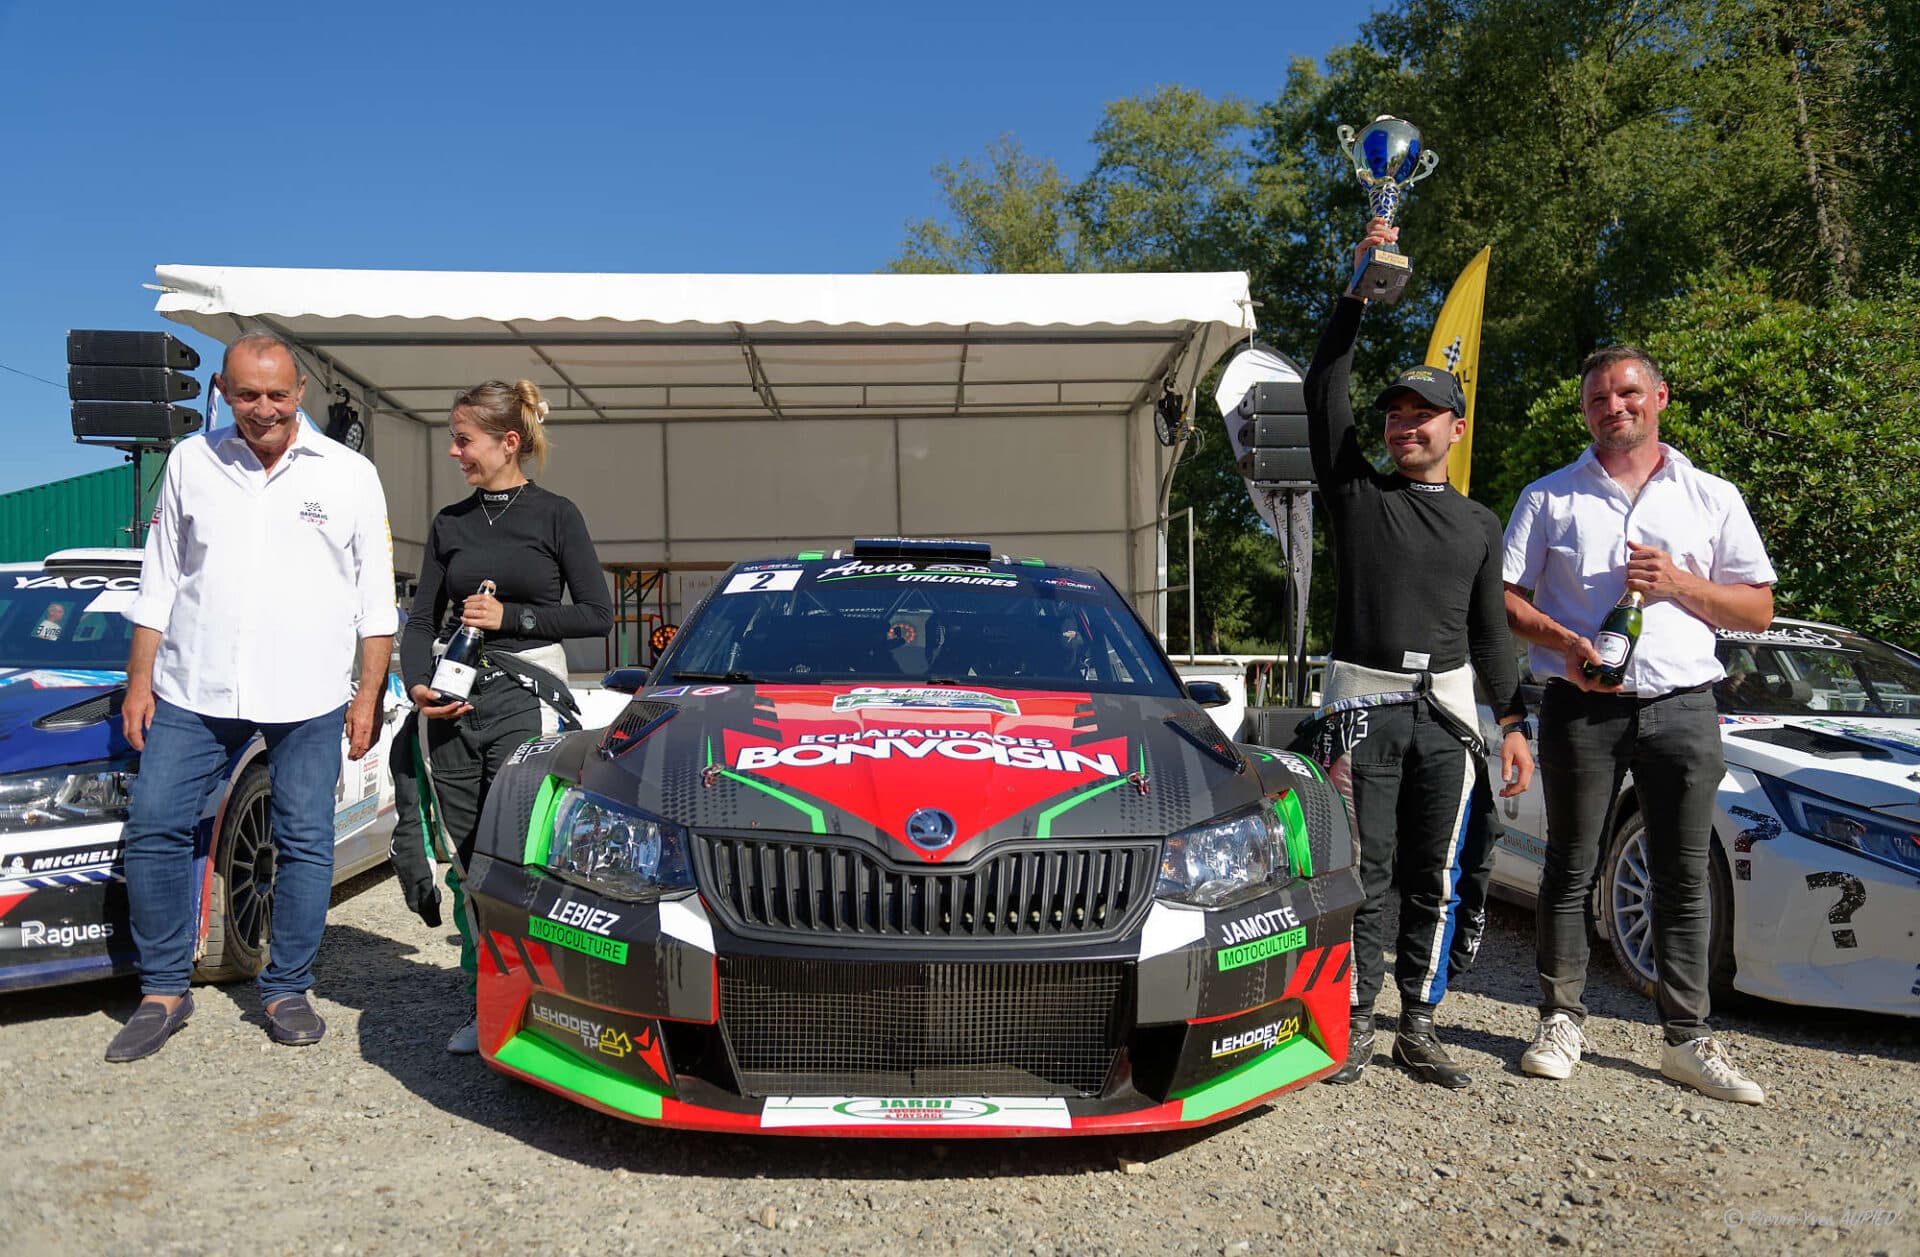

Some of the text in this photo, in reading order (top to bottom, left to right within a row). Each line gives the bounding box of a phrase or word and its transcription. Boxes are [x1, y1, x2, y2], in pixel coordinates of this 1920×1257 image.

[14, 575, 141, 590] YACC
[749, 572, 776, 590] 2
[896, 574, 1019, 587] UTILITAIRES
[799, 728, 1054, 749] ECHAFAUDAGES
[736, 738, 1121, 777] BONVOISIN
[32, 849, 120, 871] MICHELI
[547, 898, 621, 936] LEBIEZ
[1221, 906, 1300, 946] JAMOTTE
[21, 920, 114, 947] Ragues
[532, 919, 623, 960] MOTOCULTURE
[1223, 930, 1303, 967] MOTOCULTURE
[532, 1003, 602, 1037] LEHODEY
[581, 1034, 600, 1050] TP
[1212, 1020, 1282, 1055] LEHODEY
[1263, 1038, 1277, 1051] TP
[880, 1099, 952, 1109] JARDI
